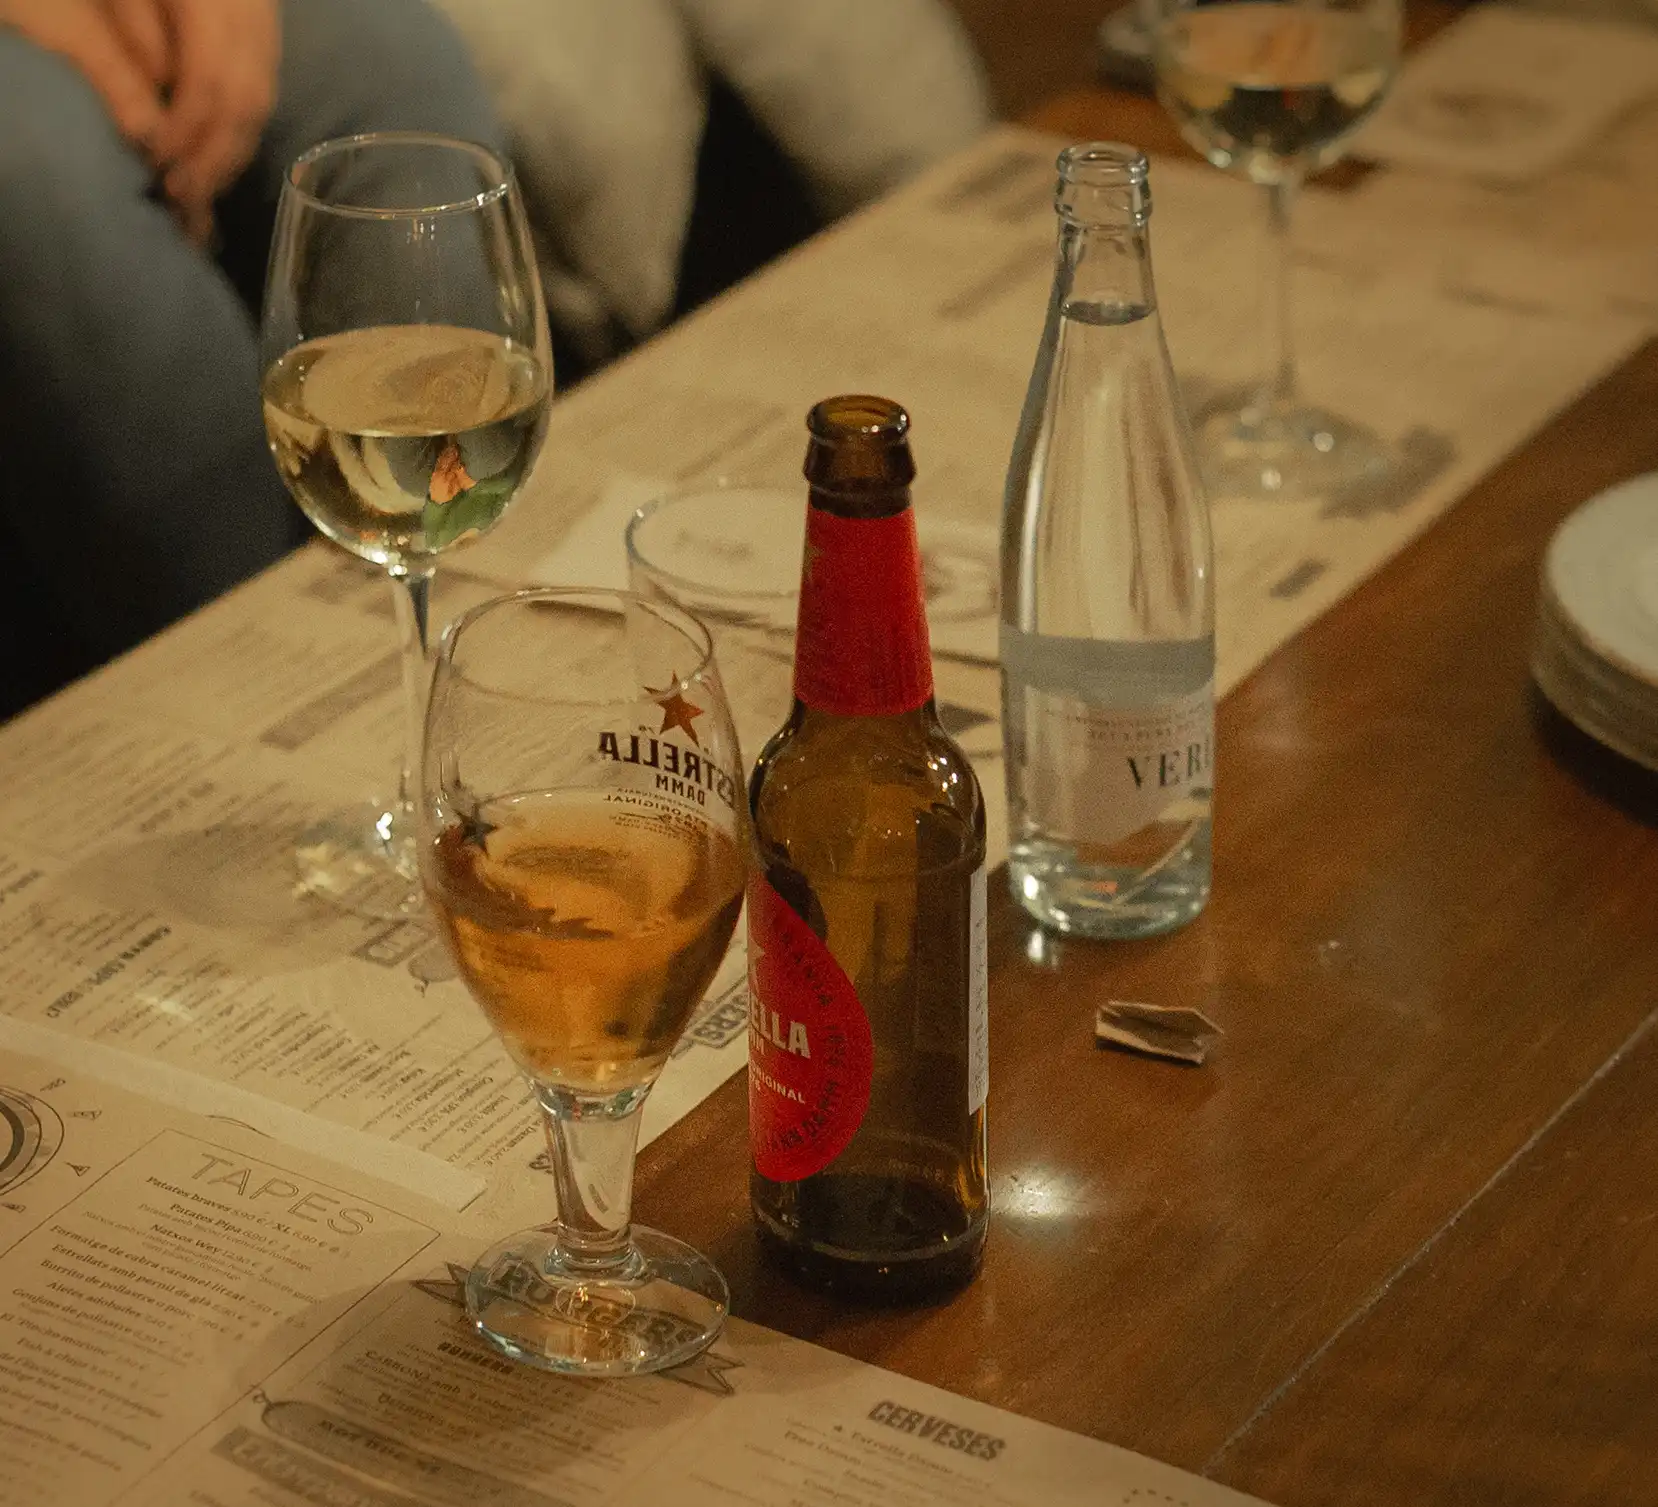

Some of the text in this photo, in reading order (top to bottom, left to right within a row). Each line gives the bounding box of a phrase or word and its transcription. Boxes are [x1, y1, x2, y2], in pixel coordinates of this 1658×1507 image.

[750, 993, 811, 1060] ELLA
[144, 1176, 192, 1197] Patates
[190, 1192, 233, 1212] braves
[271, 1222, 293, 1234] XL
[168, 1202, 216, 1224] Patates
[212, 1219, 244, 1234] Pipa
[191, 1153, 373, 1236] TAPES
[48, 1224, 109, 1251] Formatge
[106, 1245, 126, 1256] de
[122, 1251, 162, 1269] cabra
[148, 1223, 195, 1244] Natxos
[192, 1238, 223, 1254] Wey
[38, 1259, 86, 1280] Burrito
[83, 1275, 102, 1285] de
[99, 1279, 156, 1305] pollastre
[162, 1304, 196, 1320] porc
[50, 1243, 110, 1270] Estrellats
[108, 1264, 138, 1279] amb
[134, 1273, 177, 1294] pernil
[173, 1289, 192, 1299] de
[44, 1279, 86, 1299] Aletes
[83, 1292, 144, 1320] adobades
[59, 1304, 79, 1314] de
[74, 1309, 134, 1336] pollastre
[867, 1400, 1006, 1461] CERVESES
